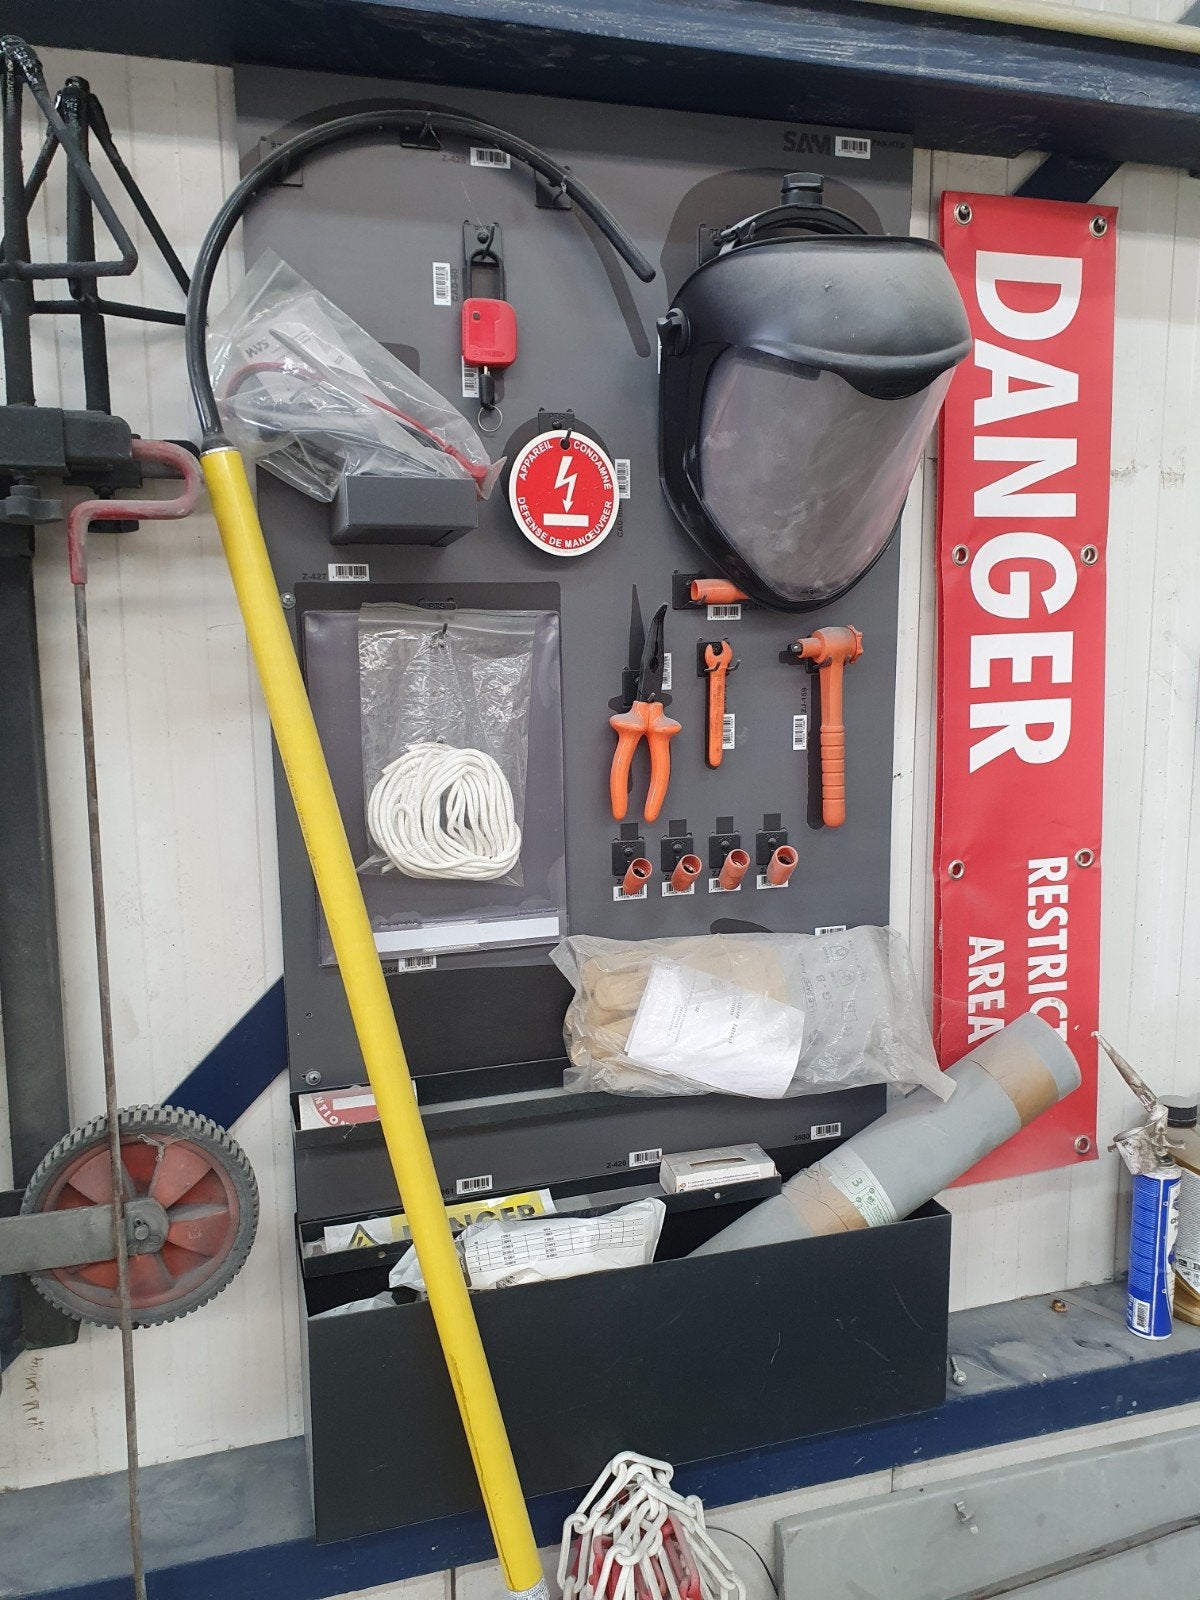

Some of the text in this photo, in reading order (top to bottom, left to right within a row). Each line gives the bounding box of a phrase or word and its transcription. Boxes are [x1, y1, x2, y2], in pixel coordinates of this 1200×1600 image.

[782, 130, 832, 156] SAM
[518, 440, 614, 491] APPAREIL CONDAMNÉ
[517, 496, 613, 548] DÉFENSE DE MANŒUVRER
[968, 249, 1083, 775] DANGER
[967, 936, 1005, 1044] AREA
